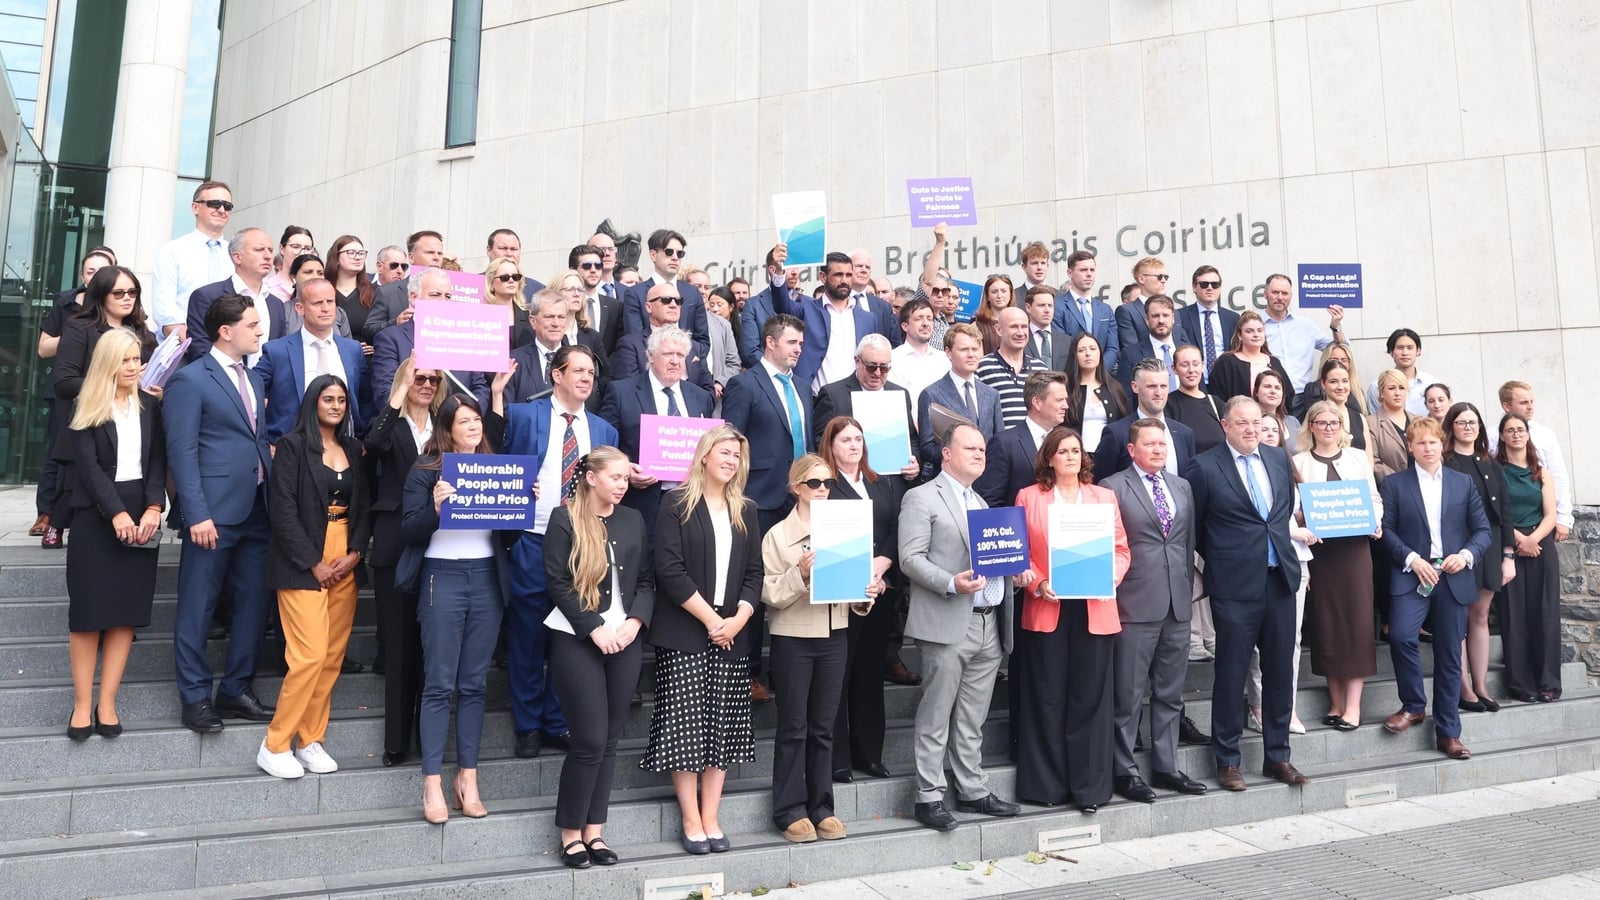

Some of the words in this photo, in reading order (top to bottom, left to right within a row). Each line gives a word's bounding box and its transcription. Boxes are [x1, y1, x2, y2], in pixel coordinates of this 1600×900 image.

[940, 185, 970, 193] Justice
[885, 230, 1098, 276] Brithiúais
[1116, 213, 1270, 257] Coiriúla
[454, 284, 479, 295] Legal
[423, 316, 432, 325] A
[433, 317, 455, 328] Cap
[456, 320, 470, 328] on
[472, 319, 502, 331] Legal
[420, 328, 505, 341] Representation
[658, 425, 678, 436] Fair
[659, 438, 686, 448] Need
[457, 462, 524, 475] Vulnerable
[456, 478, 500, 491] People
[501, 478, 524, 490] will
[1310, 486, 1360, 497] Vulnerable
[449, 494, 473, 506] Pay
[474, 493, 495, 504] the
[497, 494, 529, 505] Price
[1313, 499, 1345, 509] People
[1345, 497, 1363, 506] will
[1310, 511, 1328, 520] Pay
[1329, 510, 1345, 518] the
[1345, 508, 1369, 518] Price
[982, 527, 999, 538] 20%
[999, 526, 1015, 536] Cut.
[976, 540, 998, 552] 100%
[997, 539, 1023, 550] Wrong.
